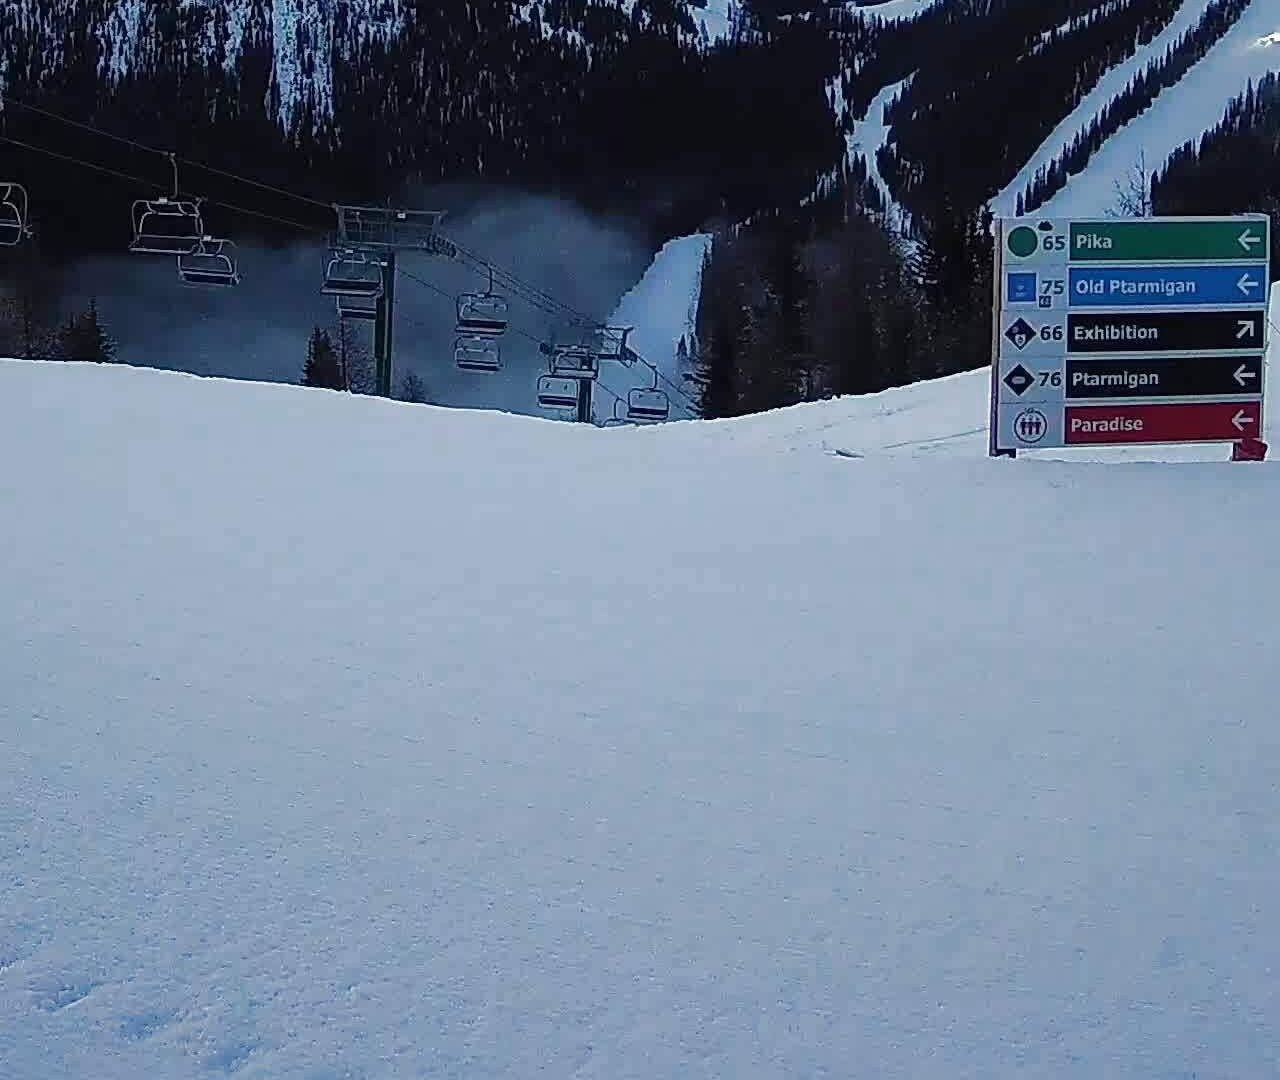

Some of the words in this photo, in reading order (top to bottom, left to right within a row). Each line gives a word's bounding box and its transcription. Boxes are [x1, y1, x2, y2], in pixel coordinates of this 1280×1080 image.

[1042, 235, 1066, 251] 65
[1075, 233, 1113, 250] Pika
[1040, 279, 1065, 295] 75
[1075, 279, 1104, 294] Old
[1109, 278, 1196, 297] Ptarmigan
[1040, 325, 1063, 341] 66
[1073, 324, 1158, 341] Exhibition
[1038, 371, 1062, 387] 76
[1072, 370, 1160, 389] Ptarmigan
[1071, 416, 1144, 433] Paradise
